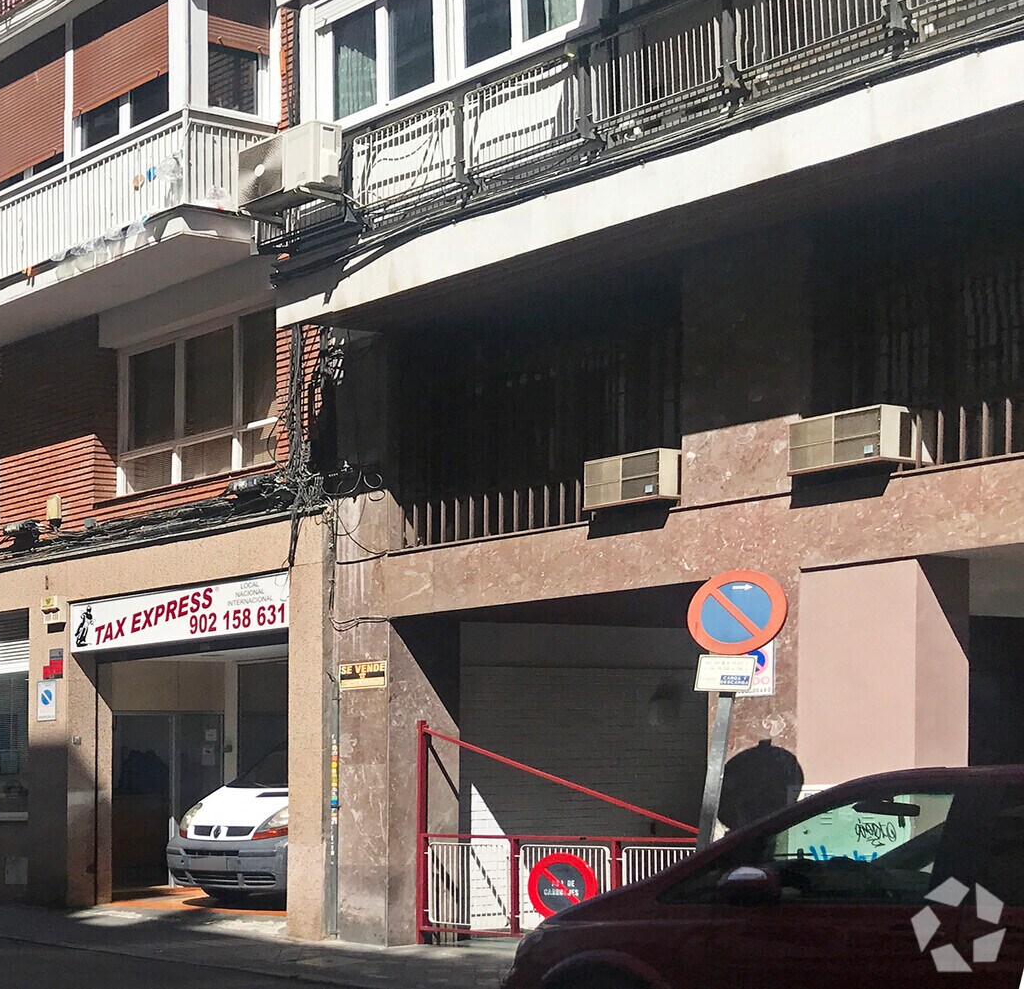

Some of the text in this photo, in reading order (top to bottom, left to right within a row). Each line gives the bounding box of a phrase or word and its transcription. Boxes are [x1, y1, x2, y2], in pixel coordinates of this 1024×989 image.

[240, 581, 259, 589] LOCAL
[235, 588, 264, 598] NACIONAL
[227, 595, 273, 606] INTERNACIONAL
[94, 587, 213, 645] TAX EXPRESS
[189, 602, 285, 634] 902 158 631
[341, 662, 385, 674] SE VENDE
